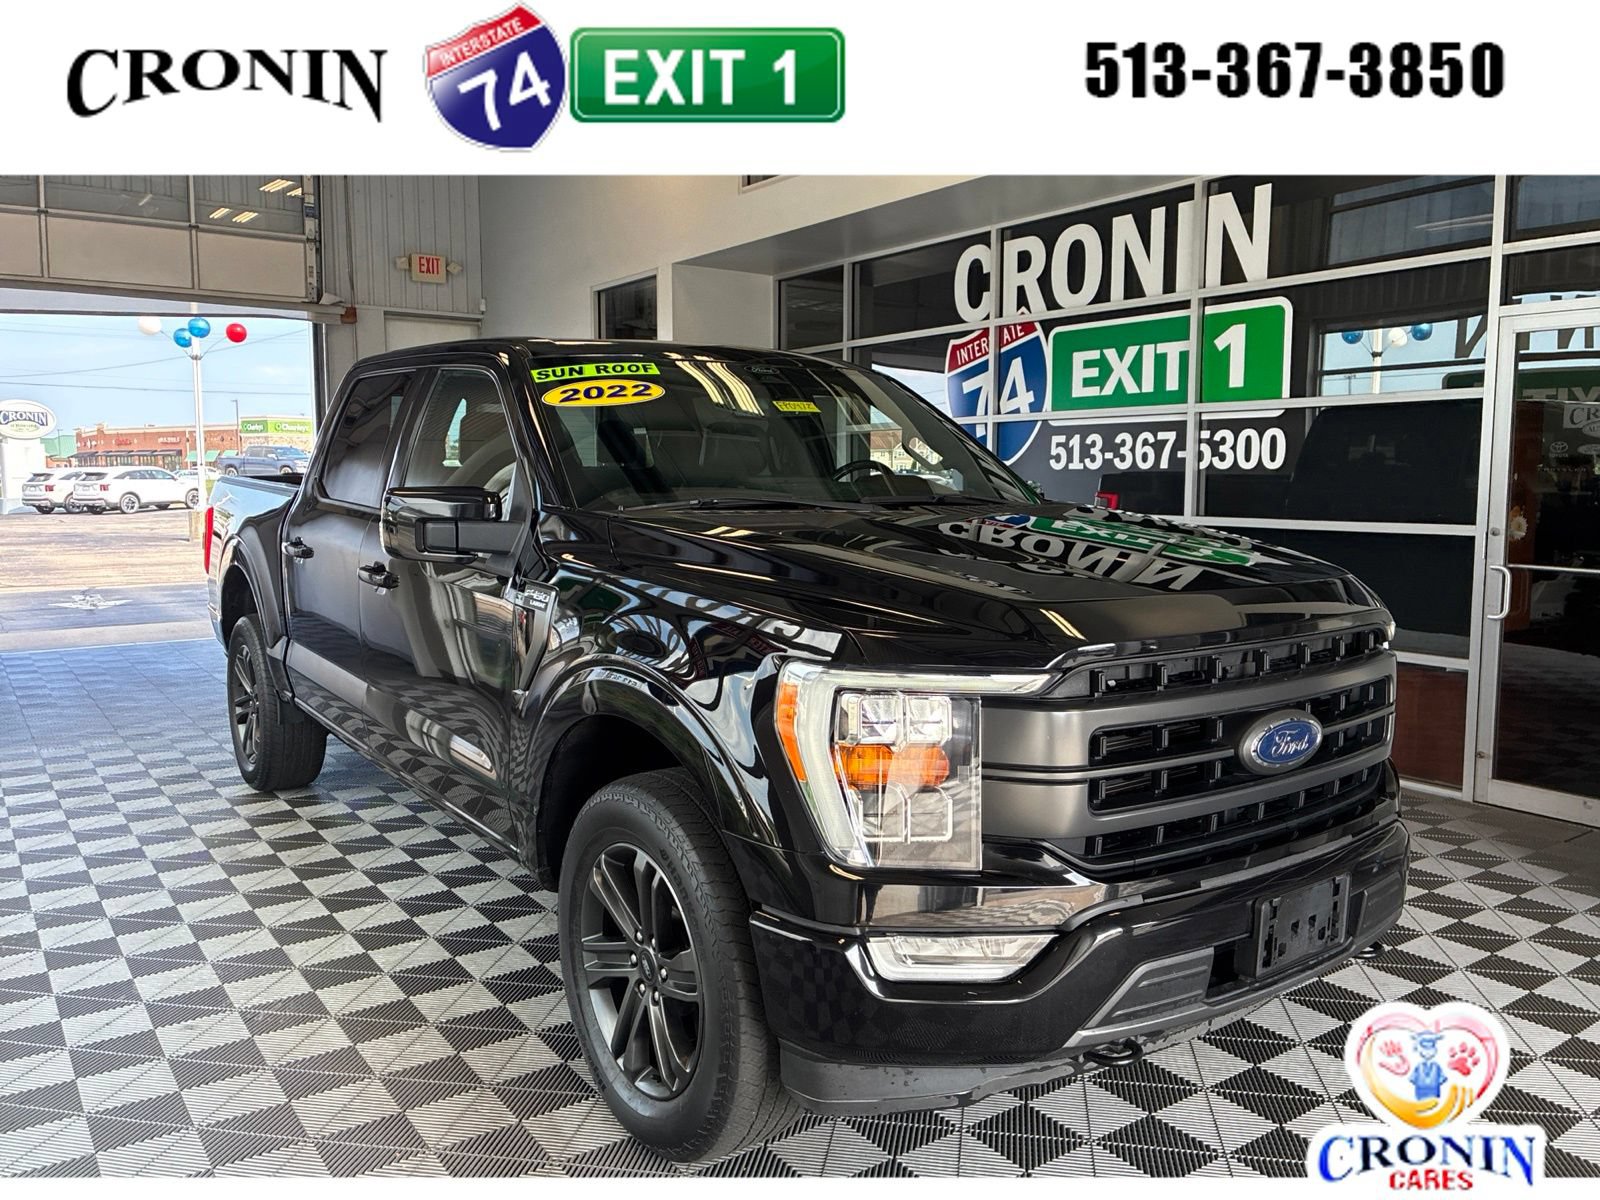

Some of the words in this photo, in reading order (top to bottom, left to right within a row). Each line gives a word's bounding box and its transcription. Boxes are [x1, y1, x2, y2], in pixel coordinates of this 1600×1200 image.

[954, 183, 1273, 323] CRONIN
[418, 256, 441, 275] EXIT
[536, 366, 584, 380] SUN
[595, 364, 653, 375] ROOF
[1072, 340, 1192, 399] EXIT
[1213, 324, 1246, 389] 1
[558, 384, 653, 403] 2022
[962, 356, 1035, 438] 74
[0, 410, 48, 426] CRONIN
[1272, 729, 1309, 758] Ford
